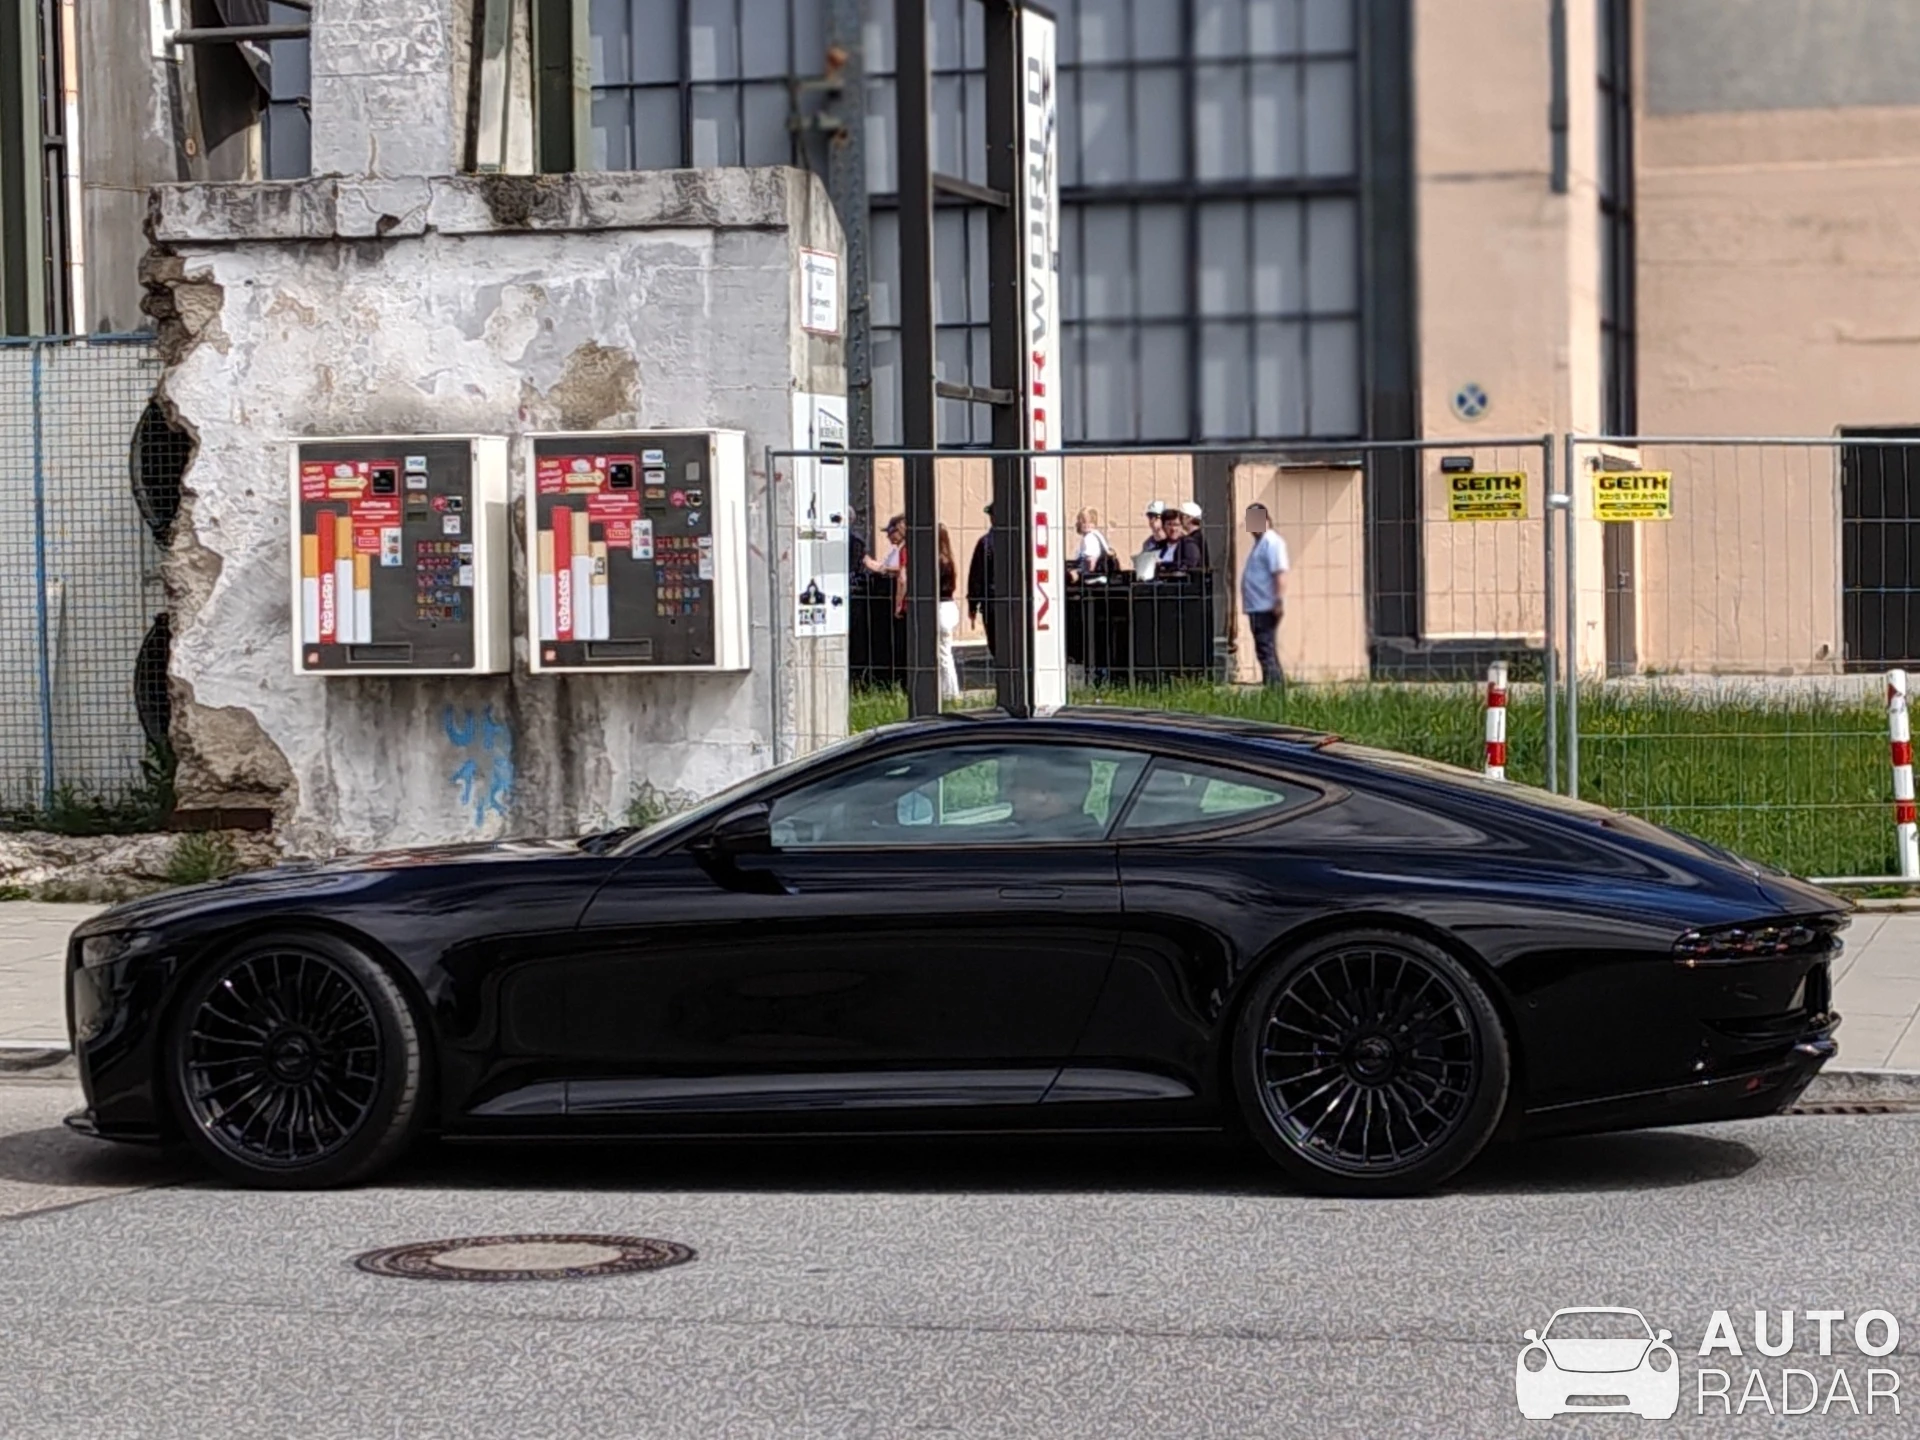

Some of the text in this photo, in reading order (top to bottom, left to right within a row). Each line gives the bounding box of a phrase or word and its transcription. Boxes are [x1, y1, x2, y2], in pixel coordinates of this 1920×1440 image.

[1027, 56, 1050, 631] MOTORWORLD
[1453, 476, 1521, 491] GEITH
[1599, 476, 1667, 490] GEITH
